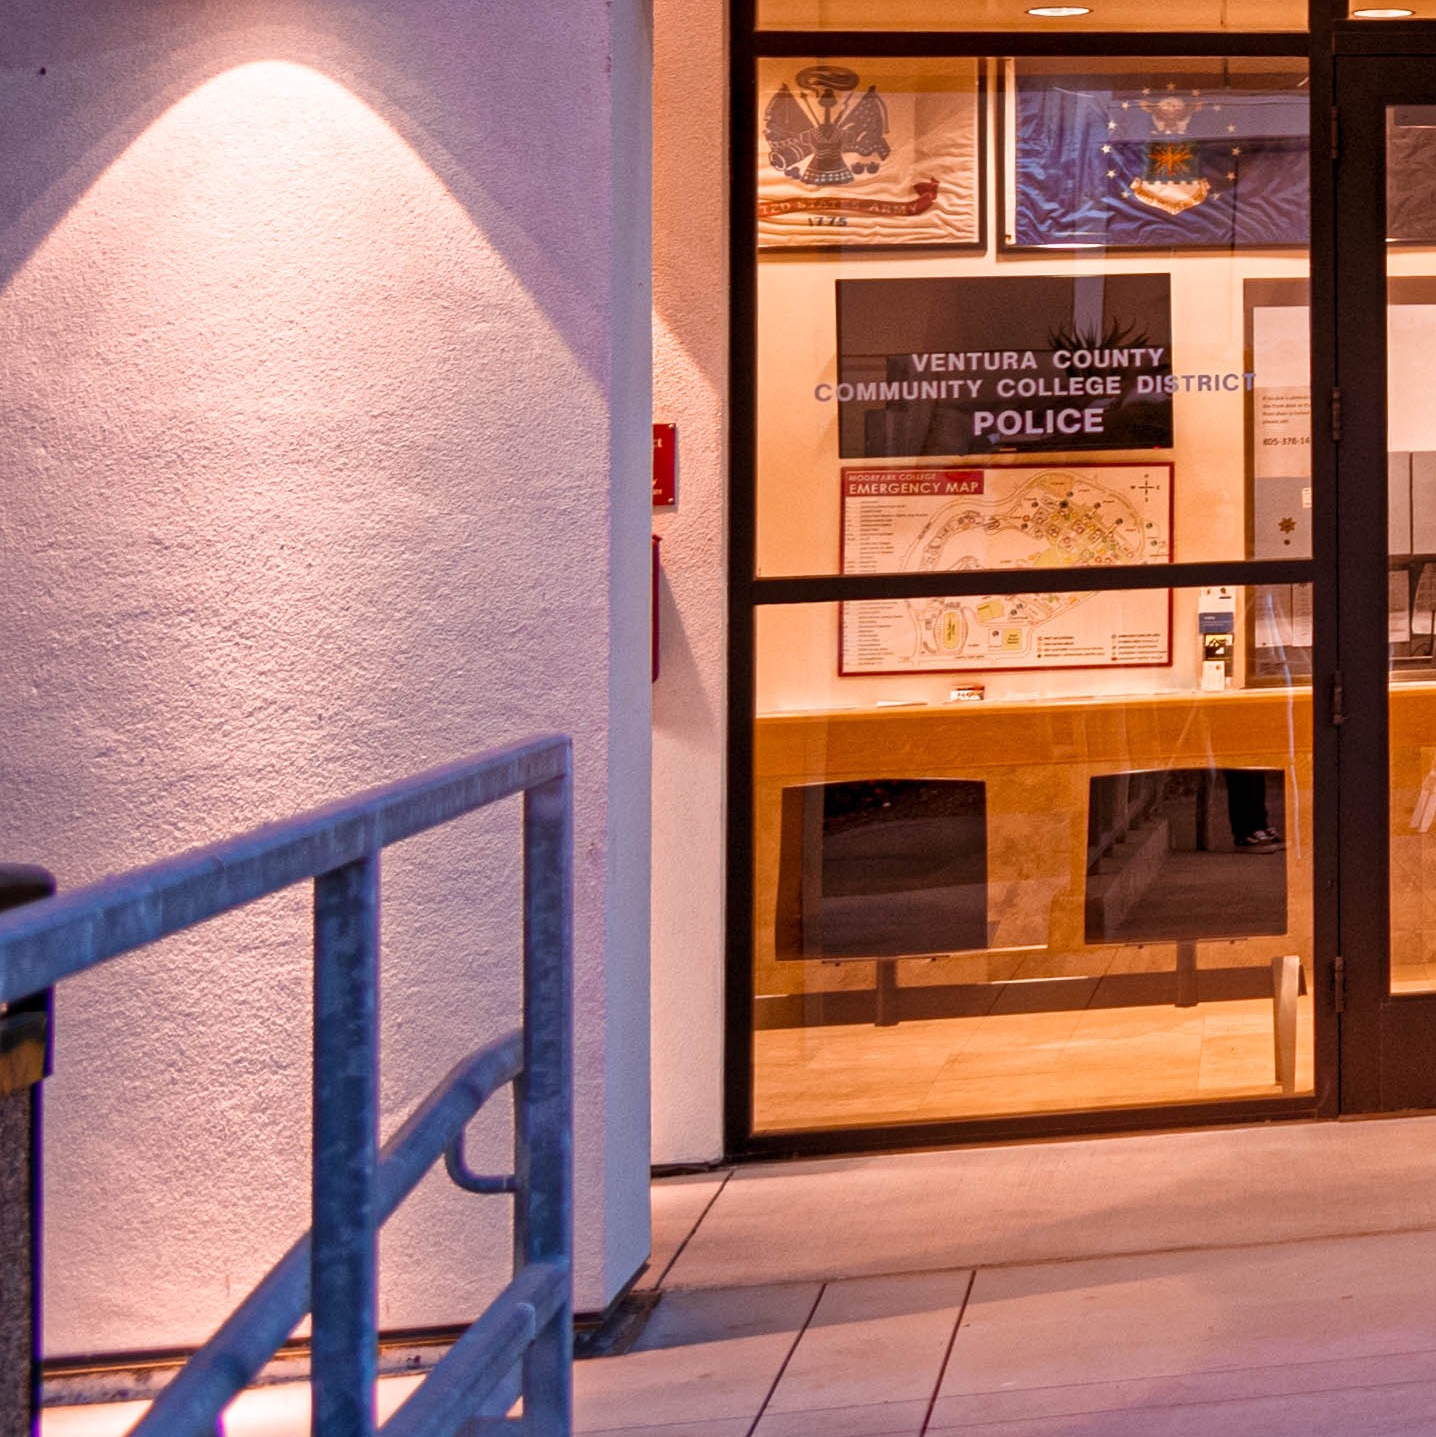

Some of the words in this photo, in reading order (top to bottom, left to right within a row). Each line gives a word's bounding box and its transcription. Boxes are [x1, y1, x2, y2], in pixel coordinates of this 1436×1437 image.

[808, 217, 848, 227] 1775
[912, 351, 1037, 372] VENTURA
[1053, 348, 1164, 368] COUNTY
[814, 378, 982, 402] COMMUNITY
[997, 376, 1121, 398] COLLEGE
[1137, 373, 1256, 394] DISTRICT
[974, 408, 1104, 436] POLICE
[899, 473, 936, 481] COLLEGE
[849, 483, 940, 494] EMERGENCY
[945, 481, 979, 493] MAP
